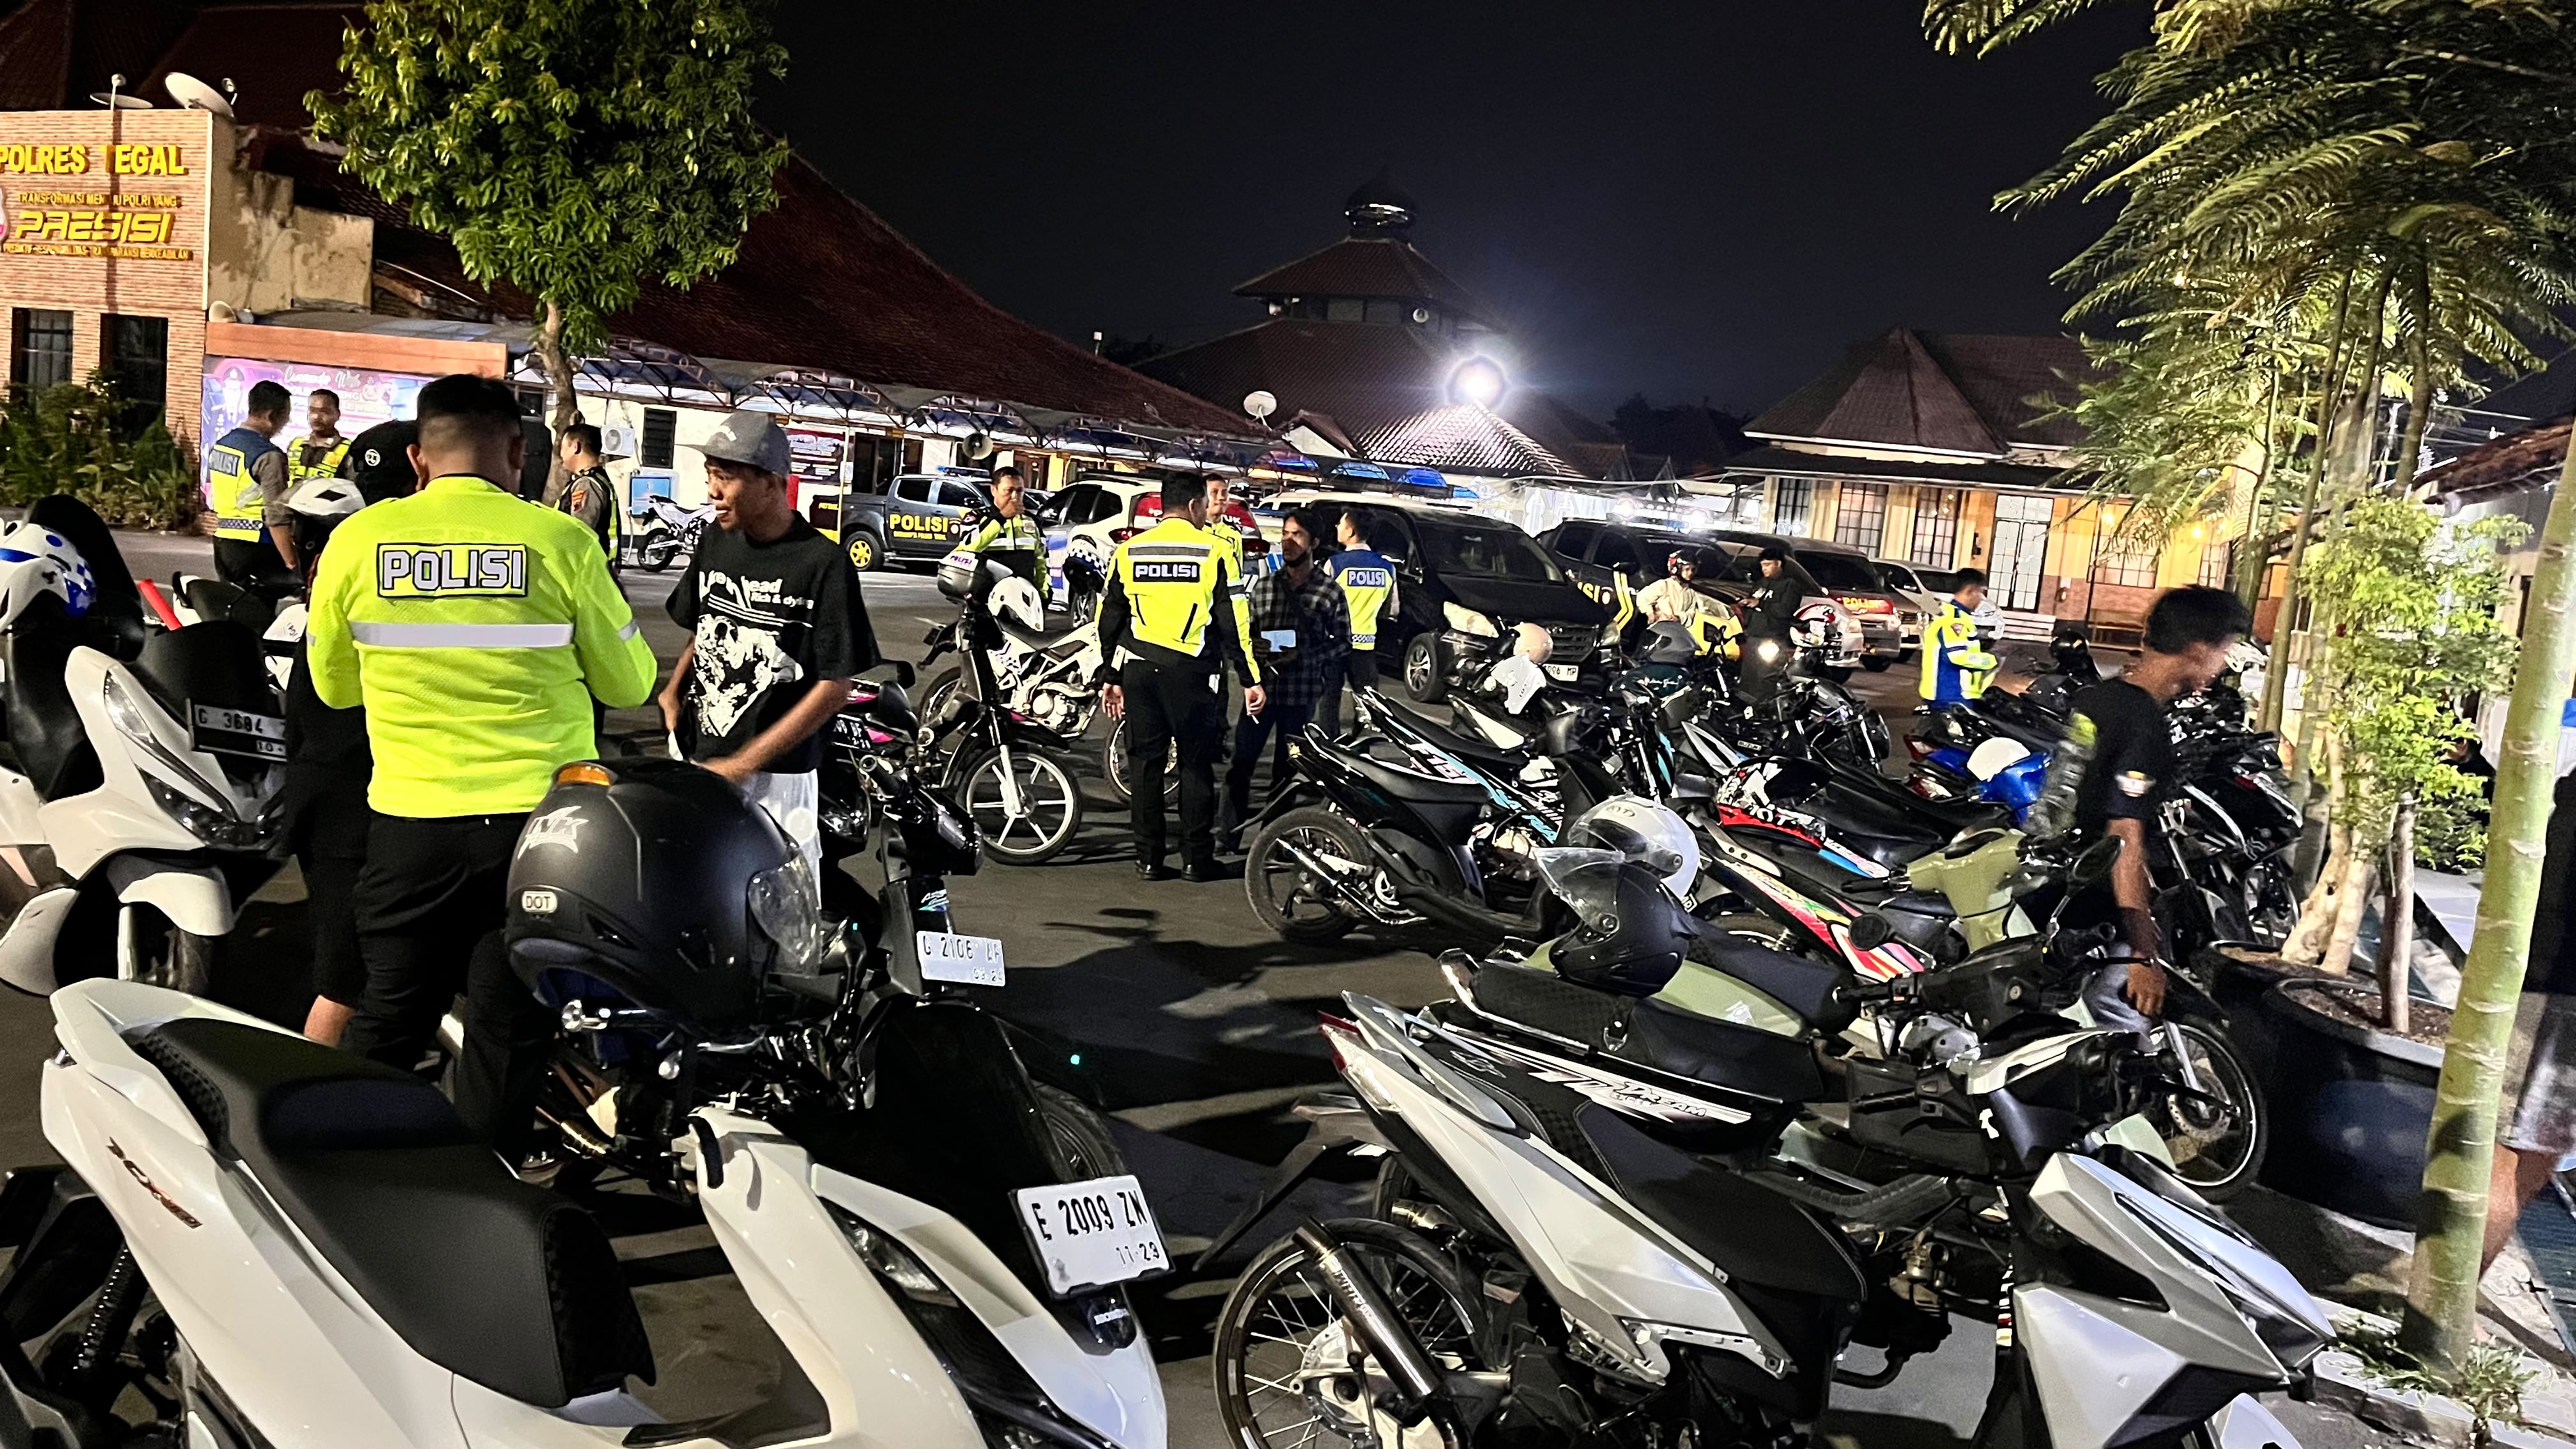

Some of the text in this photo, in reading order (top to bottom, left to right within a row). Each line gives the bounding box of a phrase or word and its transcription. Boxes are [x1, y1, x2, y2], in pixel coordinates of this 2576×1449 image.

[889, 514, 949, 533] POLISI
[382, 550, 523, 590] POLISI
[1135, 564, 1197, 578] POLISI
[1349, 571, 1384, 585] POLISI
[525, 896, 551, 909] DOT
[940, 937, 973, 959] 2106
[1031, 1190, 1147, 1241] E 2009 ZN
